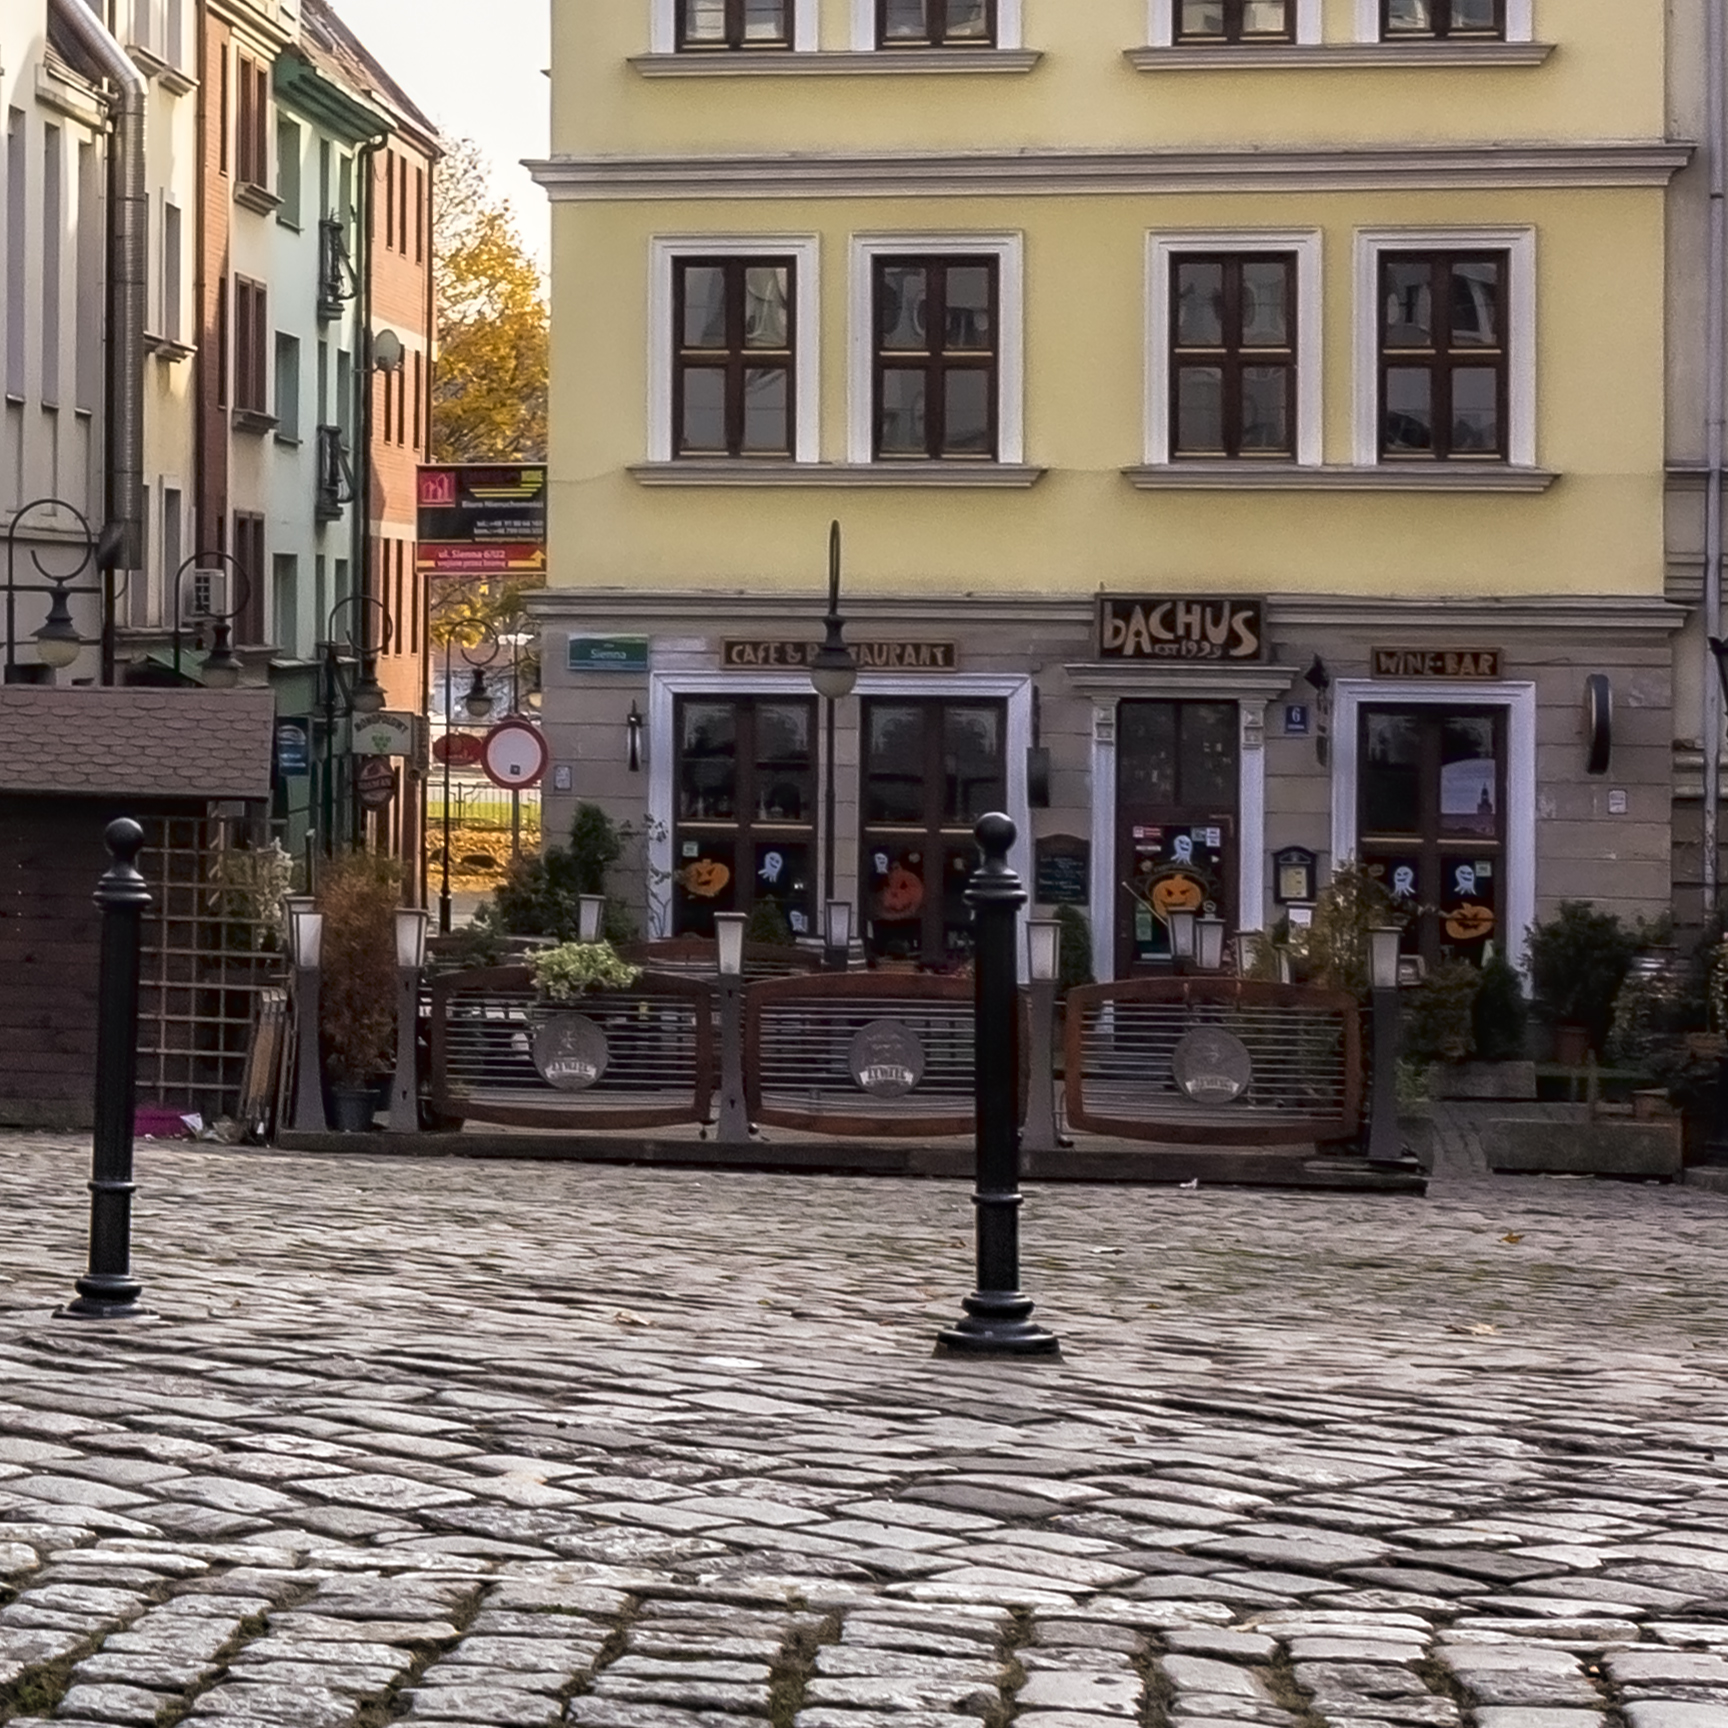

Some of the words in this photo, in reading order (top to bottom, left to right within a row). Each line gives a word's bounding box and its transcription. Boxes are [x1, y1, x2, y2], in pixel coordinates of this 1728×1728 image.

[590, 648, 627, 660] Sienna
[806, 643, 947, 666] RTAURANT
[1291, 706, 1301, 723] 6
